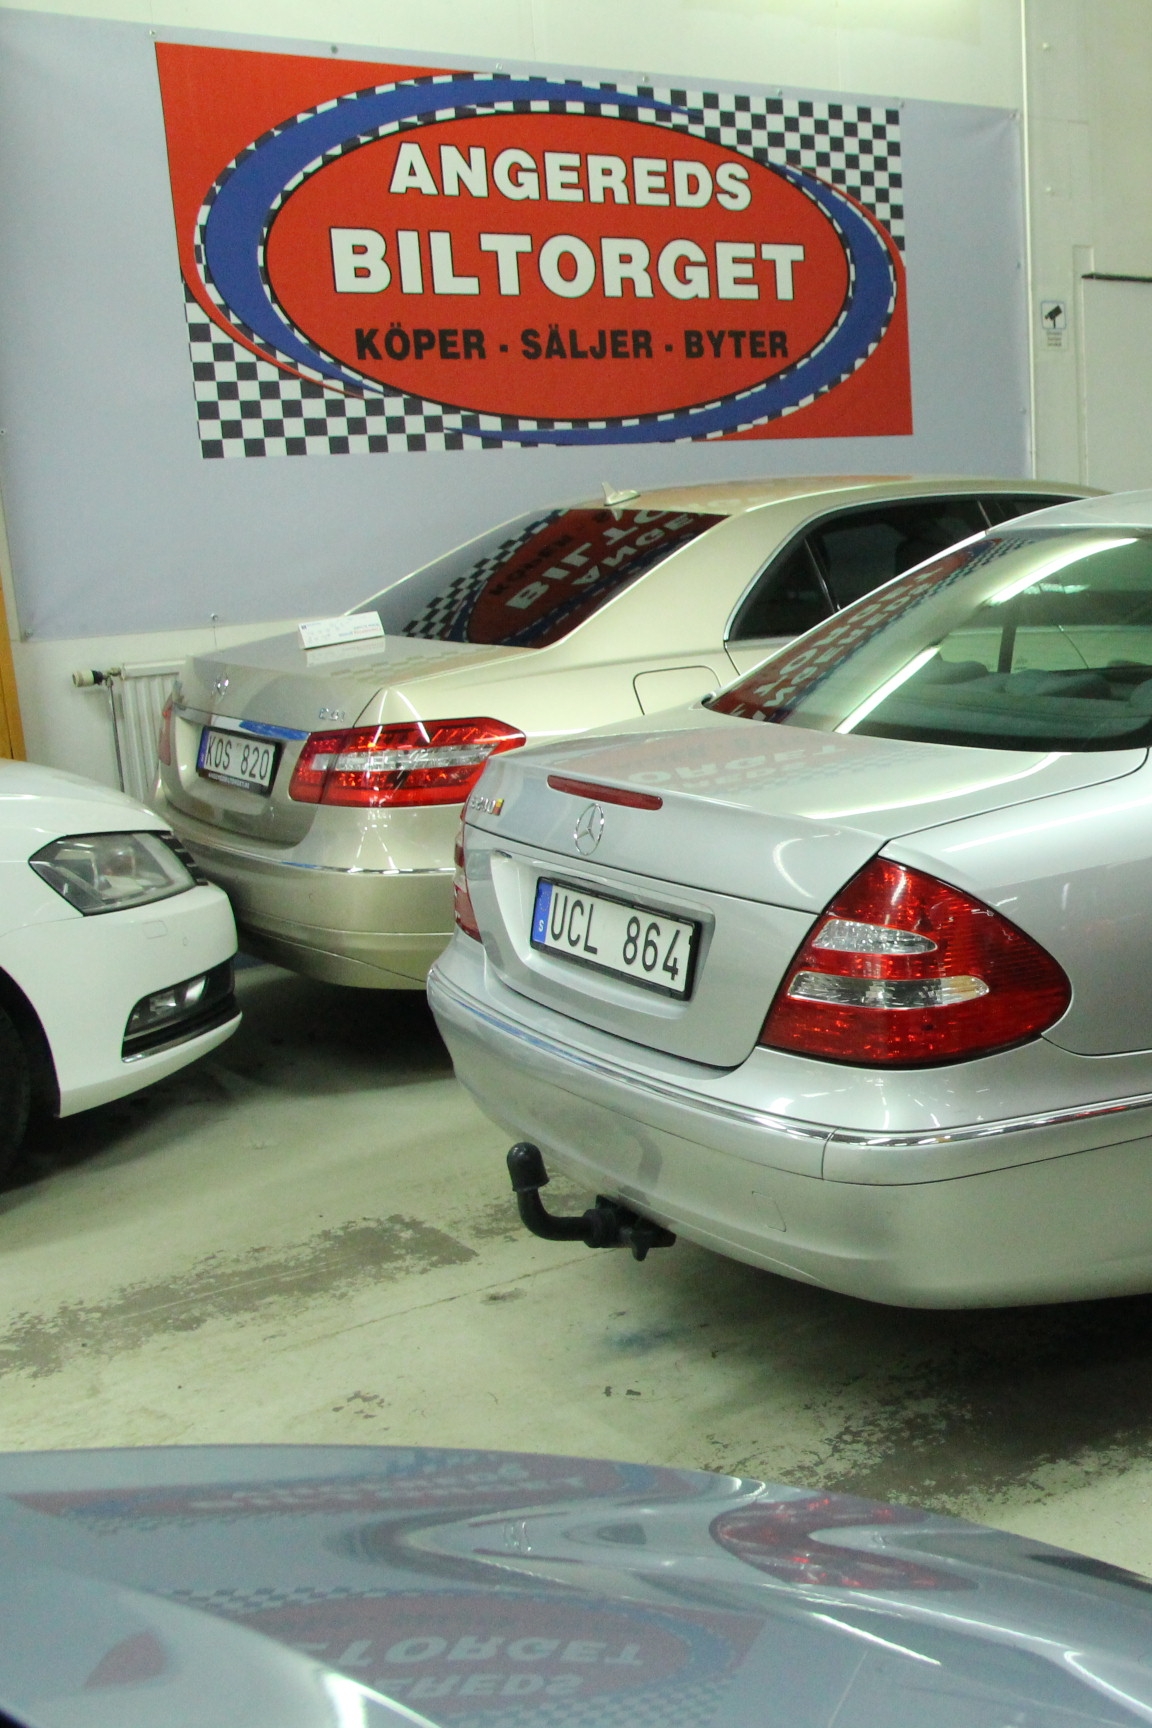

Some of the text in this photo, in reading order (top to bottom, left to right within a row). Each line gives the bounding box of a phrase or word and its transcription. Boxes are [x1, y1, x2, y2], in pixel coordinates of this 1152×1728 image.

[388, 141, 752, 212] ANGEREDS
[328, 226, 806, 301] BILTORGET
[355, 322, 487, 360] KÖPER
[521, 324, 653, 360] SÄLJER
[684, 330, 789, 359] BYTER
[205, 734, 232, 771] KOS
[240, 744, 270, 781] 820
[549, 891, 682, 982] UCL 864
